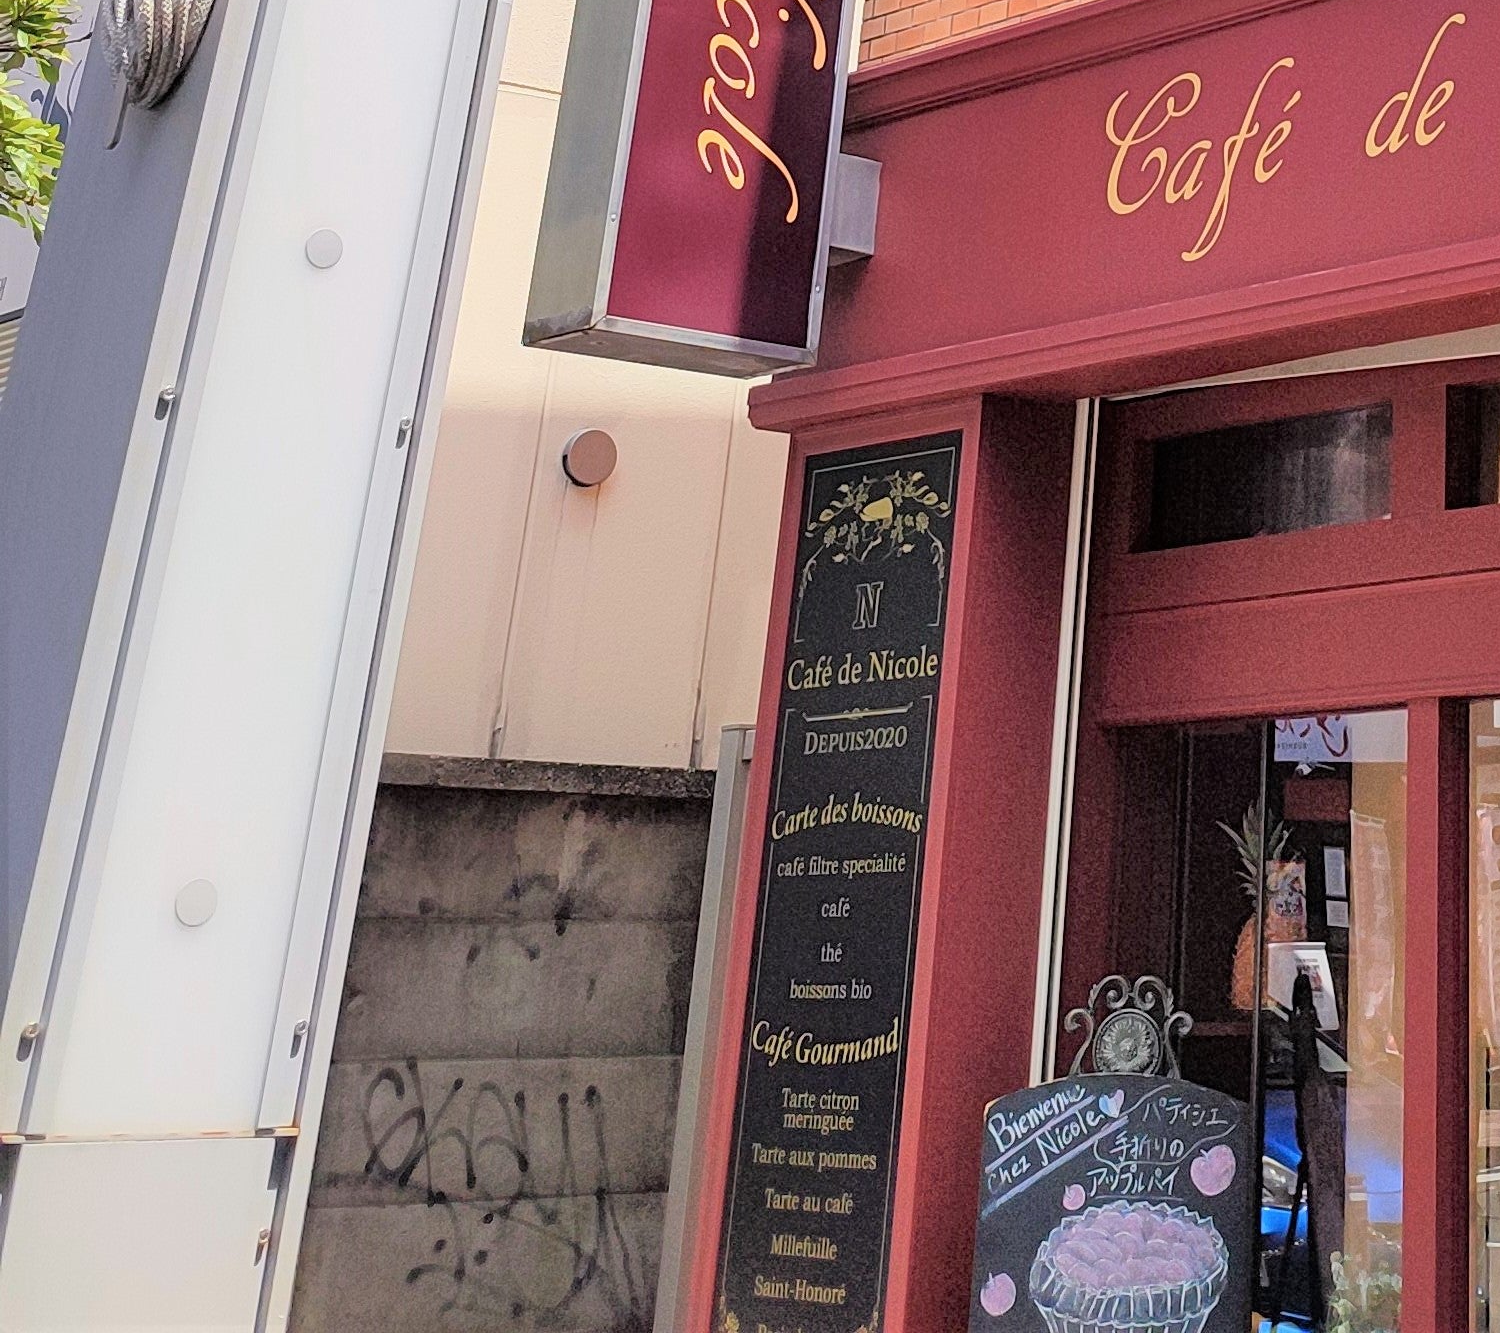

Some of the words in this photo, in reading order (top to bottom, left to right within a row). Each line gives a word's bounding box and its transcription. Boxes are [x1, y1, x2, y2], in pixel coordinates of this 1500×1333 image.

[1105, 57, 1302, 262] Café
[1365, 13, 1466, 158] de
[787, 654, 834, 692] Café
[838, 652, 862, 686] de
[866, 644, 939, 683] Nicole
[772, 801, 820, 841] Carte
[821, 793, 849, 825] des
[850, 791, 923, 835] boissons
[776, 856, 806, 878] café
[807, 855, 839, 877] filtre
[820, 898, 851, 919] café
[820, 942, 844, 963] thé
[789, 978, 847, 1000] boissons
[850, 978, 873, 1000] bio
[752, 1019, 795, 1068] Café
[795, 1016, 900, 1066] Gourmand
[781, 1087, 818, 1112] Tarte
[819, 1088, 861, 1112] citron
[1035, 1109, 1106, 1168] Nicole
[751, 1143, 788, 1167] Tarte
[789, 1147, 815, 1168] aux
[817, 1150, 878, 1173] pommes
[1086, 1163, 1180, 1197] アップルパイ
[764, 1187, 801, 1211] Tarte
[802, 1194, 822, 1213] au
[824, 1191, 855, 1215] café
